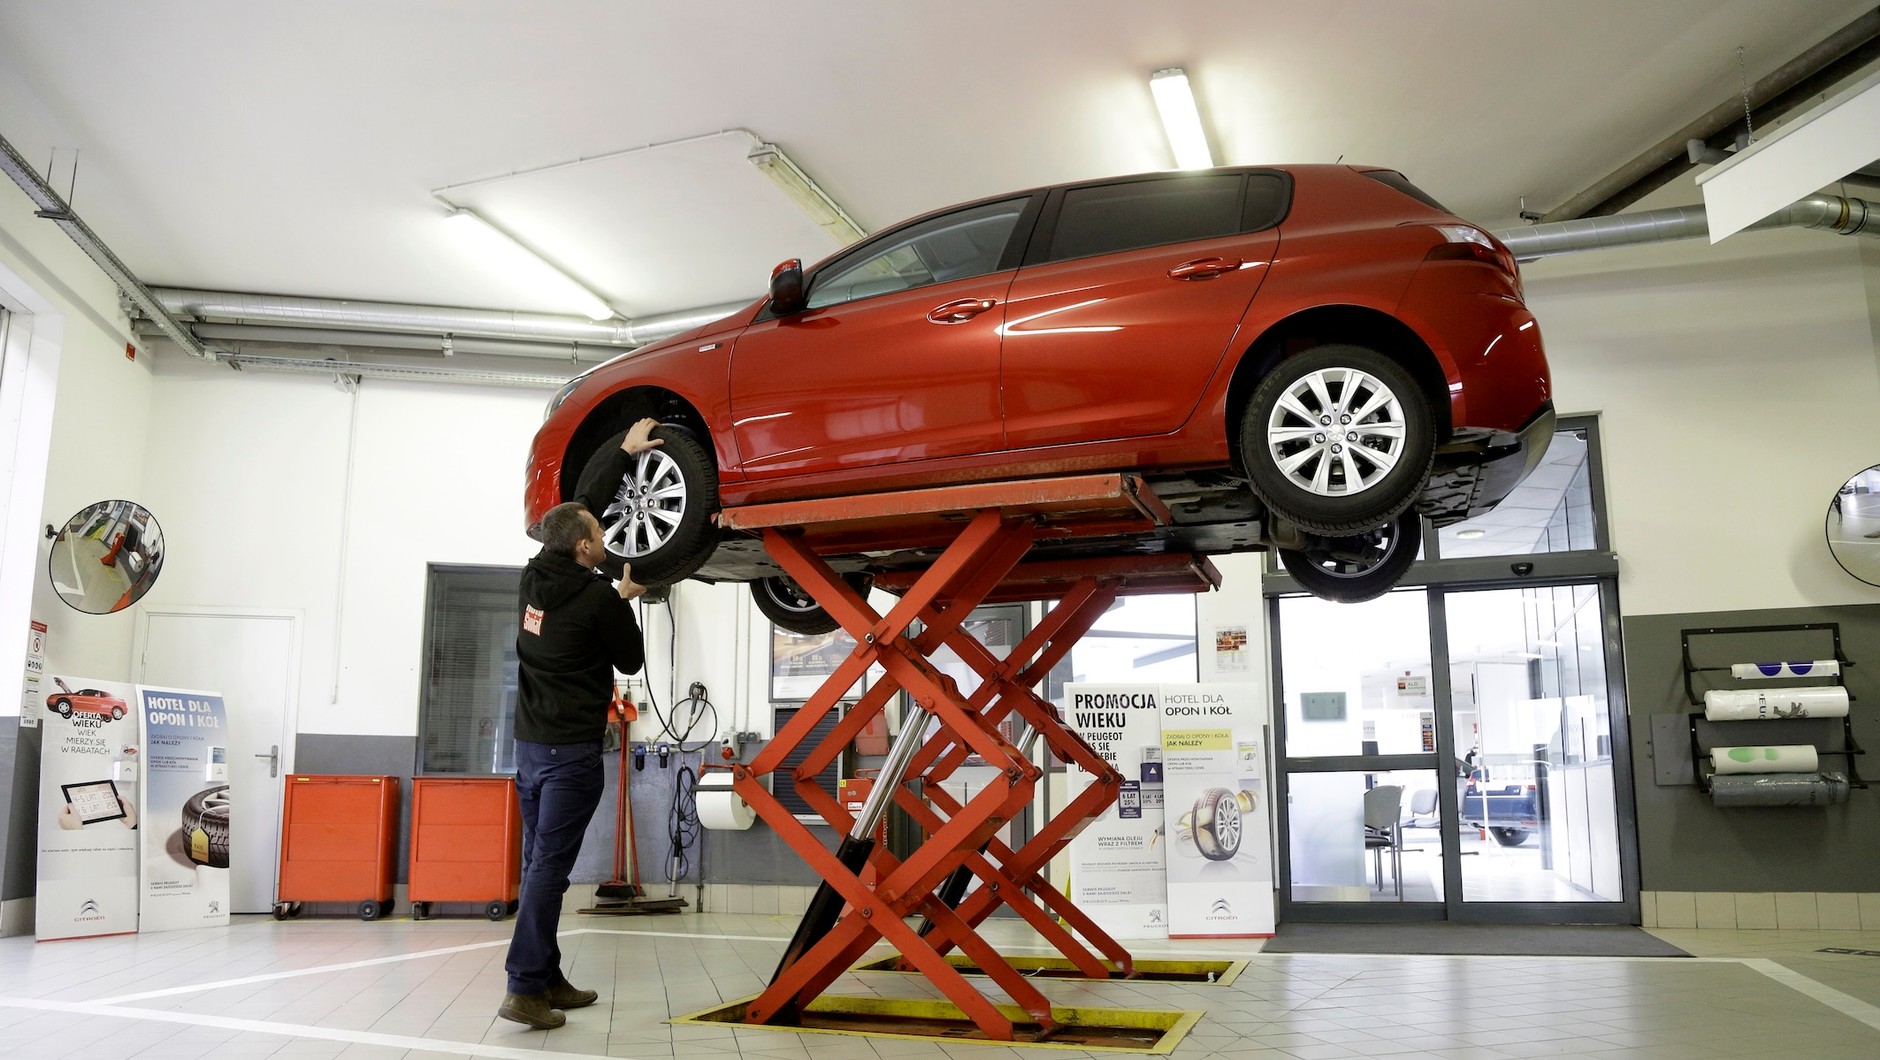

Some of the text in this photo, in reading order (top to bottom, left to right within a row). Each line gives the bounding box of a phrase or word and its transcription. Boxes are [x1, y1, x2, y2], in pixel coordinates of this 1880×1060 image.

[1075, 694, 1156, 709] PROMOCJA
[1164, 694, 1224, 704] HOTEL DLA
[148, 697, 212, 713] HOTEL DLA
[1165, 704, 1232, 716] OPON I KÓŁ
[73, 711, 102, 719] OFERTA
[150, 712, 220, 728] OPON I KÓŁ
[1076, 712, 1126, 728] WIEKU
[72, 720, 102, 728] WIEKU
[1088, 732, 1122, 740] PEUGEOT
[66, 737, 106, 748] MIERZY SIĘ
[1099, 742, 1110, 752] SIĘ
[71, 746, 110, 755] RABATACH
[89, 804, 100, 812] LAT
